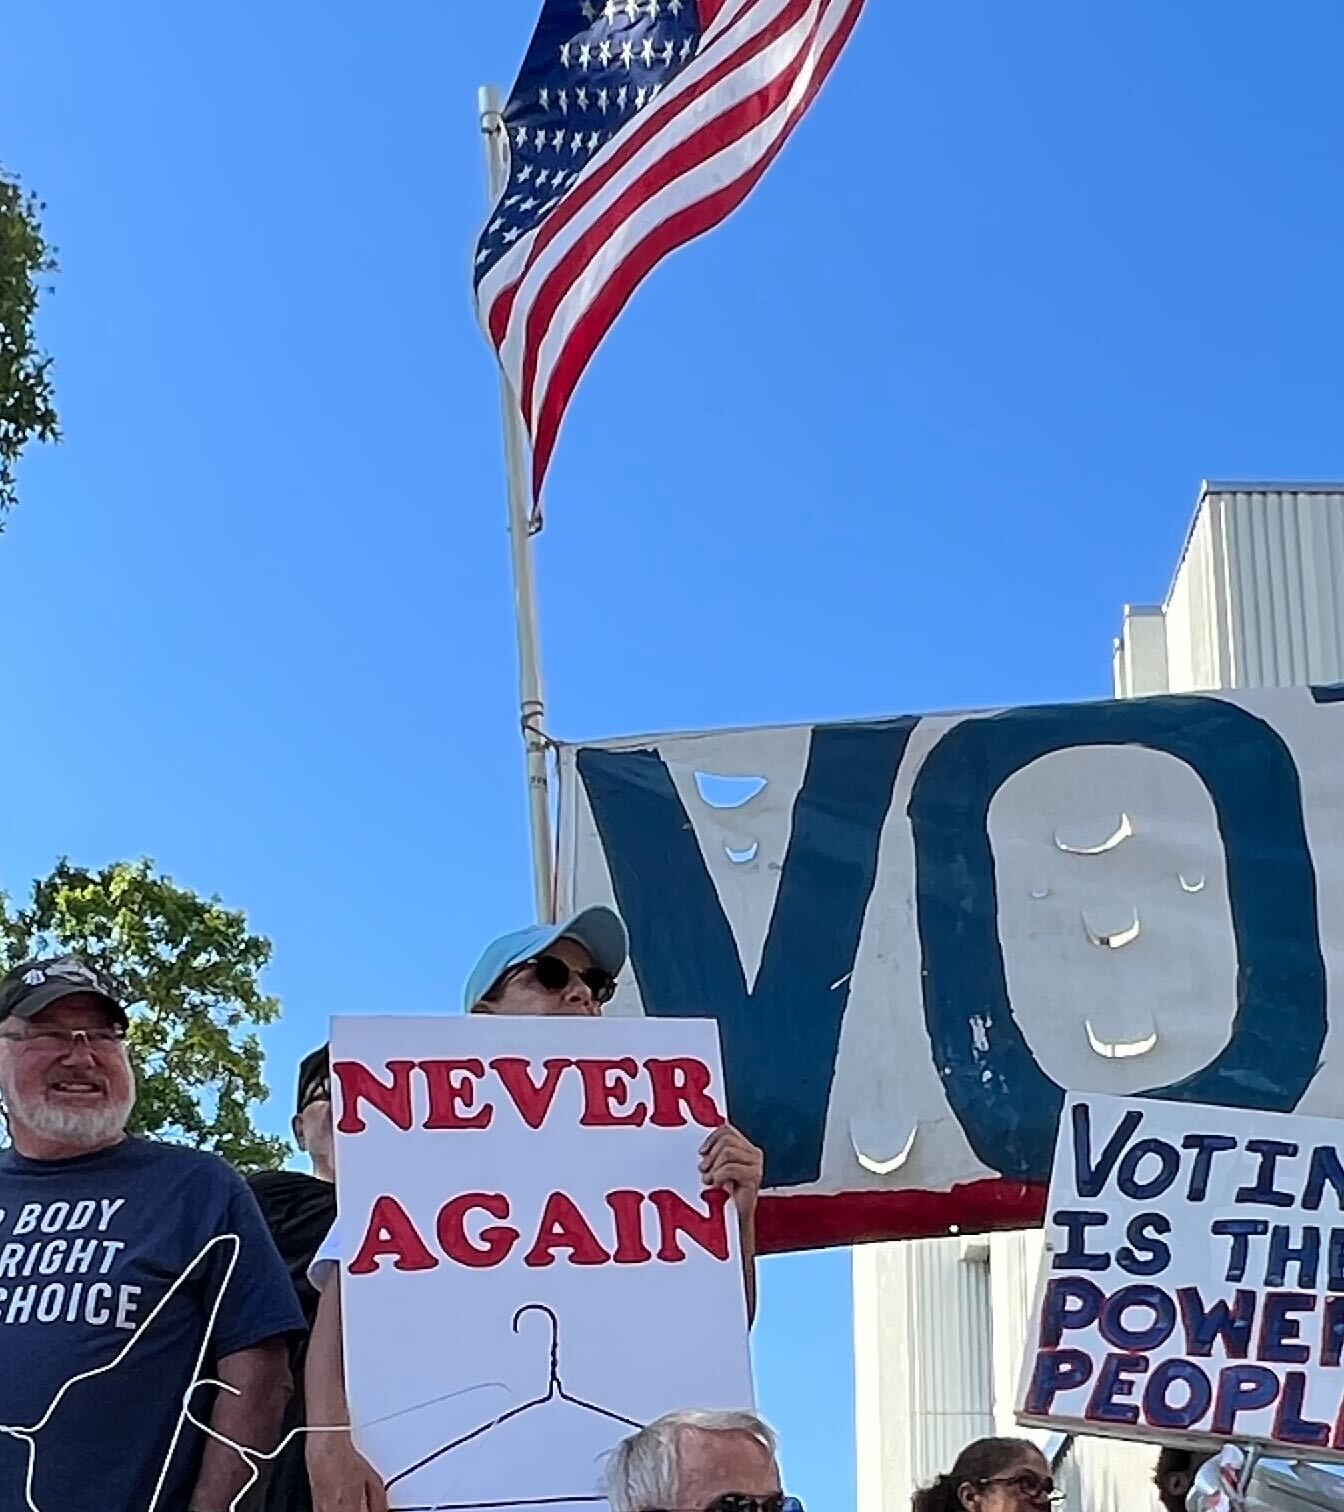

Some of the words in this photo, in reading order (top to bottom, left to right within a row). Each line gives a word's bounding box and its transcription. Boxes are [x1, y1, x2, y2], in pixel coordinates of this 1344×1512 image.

[333, 1057, 725, 1134] NEVER
[12, 1198, 126, 1236] BODY
[348, 1189, 731, 1275] AGAIN
[1052, 1211, 1171, 1276] IS
